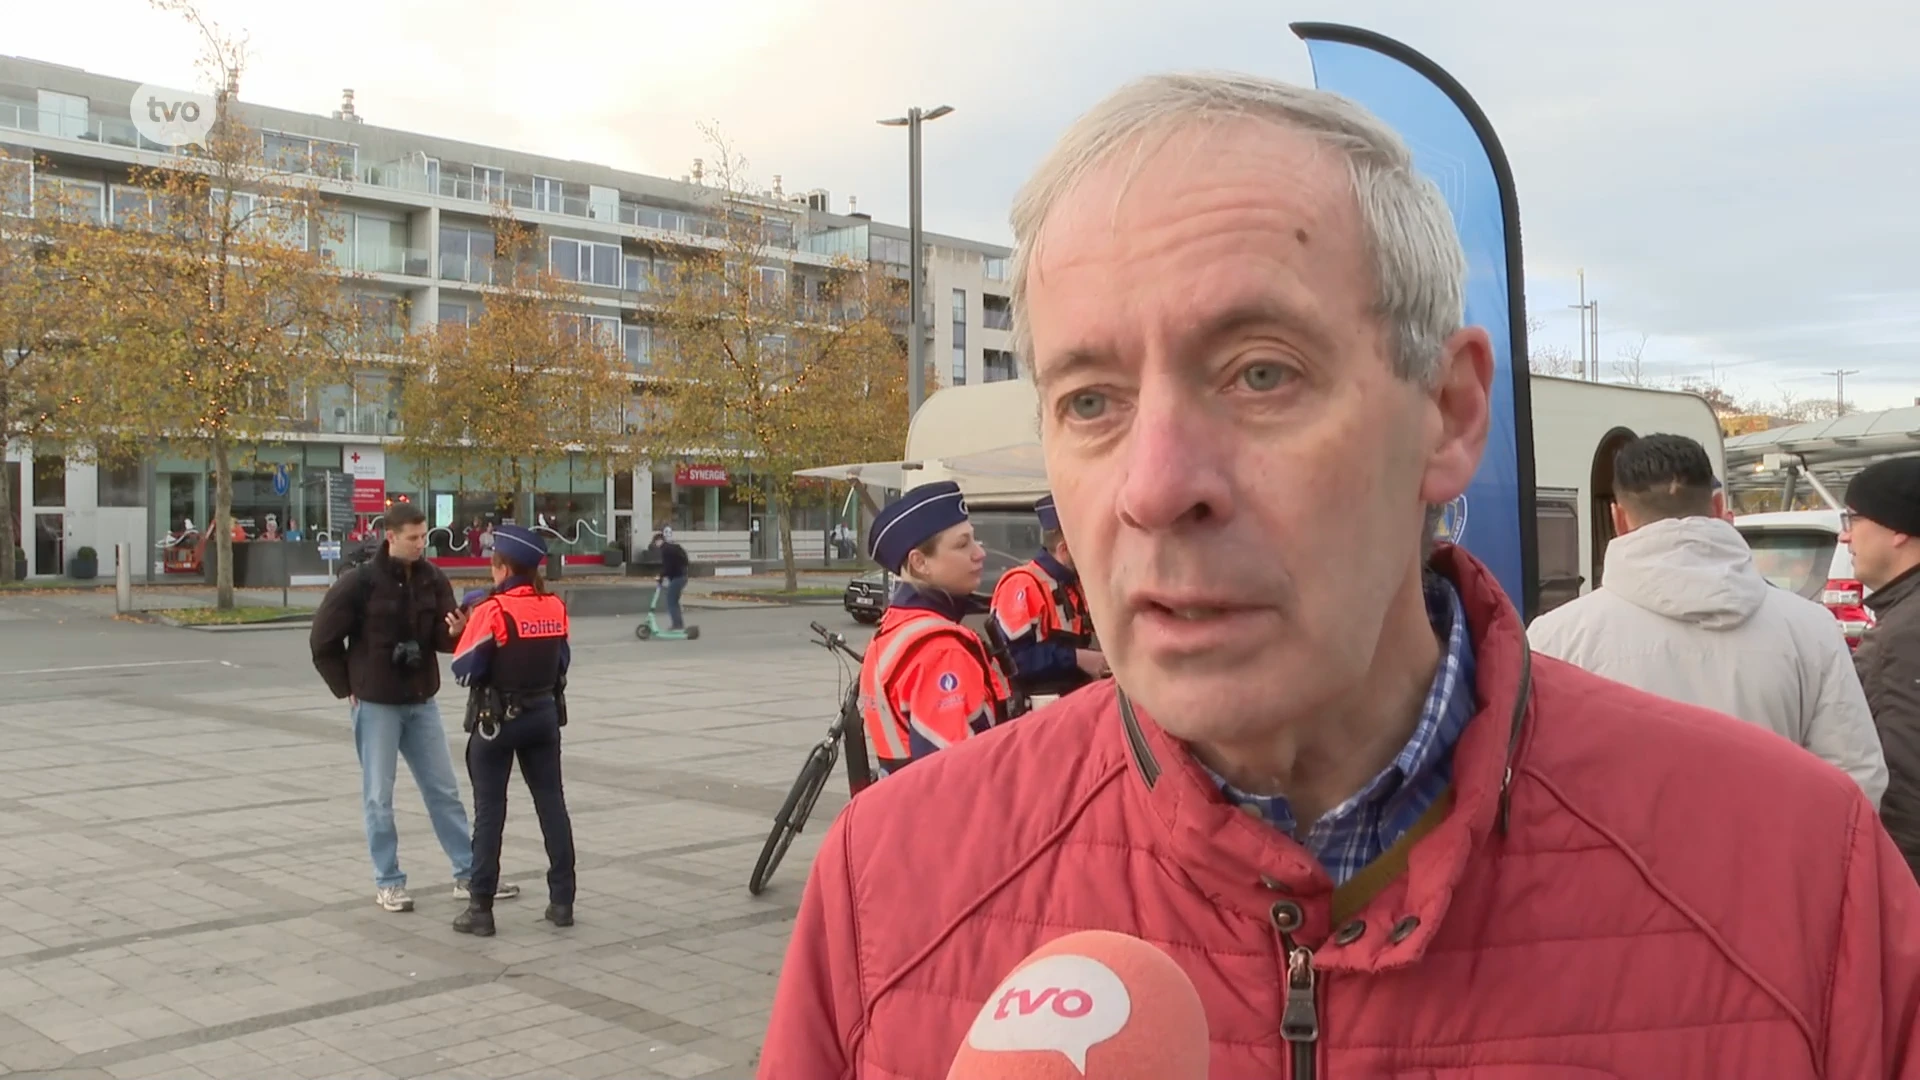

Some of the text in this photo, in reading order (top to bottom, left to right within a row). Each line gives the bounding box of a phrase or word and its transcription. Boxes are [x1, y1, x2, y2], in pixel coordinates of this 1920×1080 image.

[689, 469, 727, 480] SYNERGIE
[521, 619, 562, 635] Politie
[993, 986, 1093, 1020] tvo
